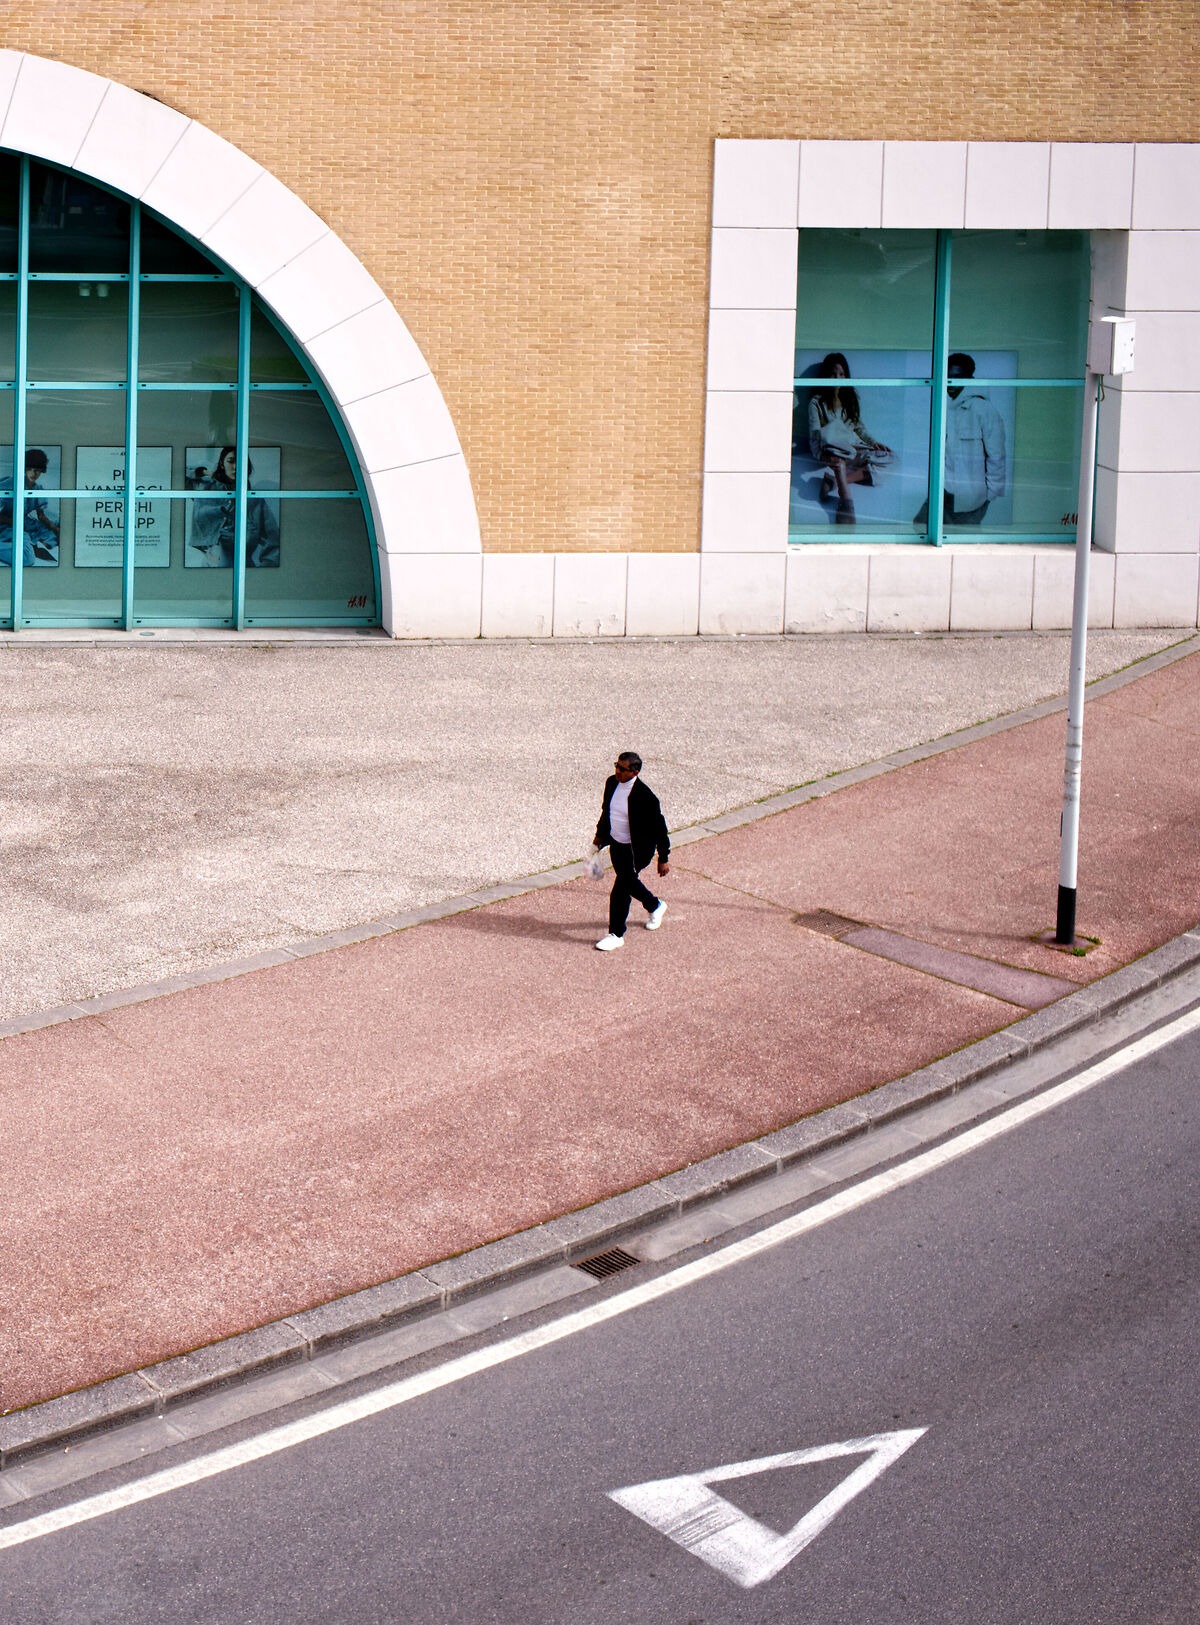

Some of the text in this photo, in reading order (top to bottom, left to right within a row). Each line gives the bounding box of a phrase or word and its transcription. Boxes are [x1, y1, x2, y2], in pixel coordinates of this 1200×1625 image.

[95, 501, 152, 513] PER HI
[92, 517, 113, 529] HA
